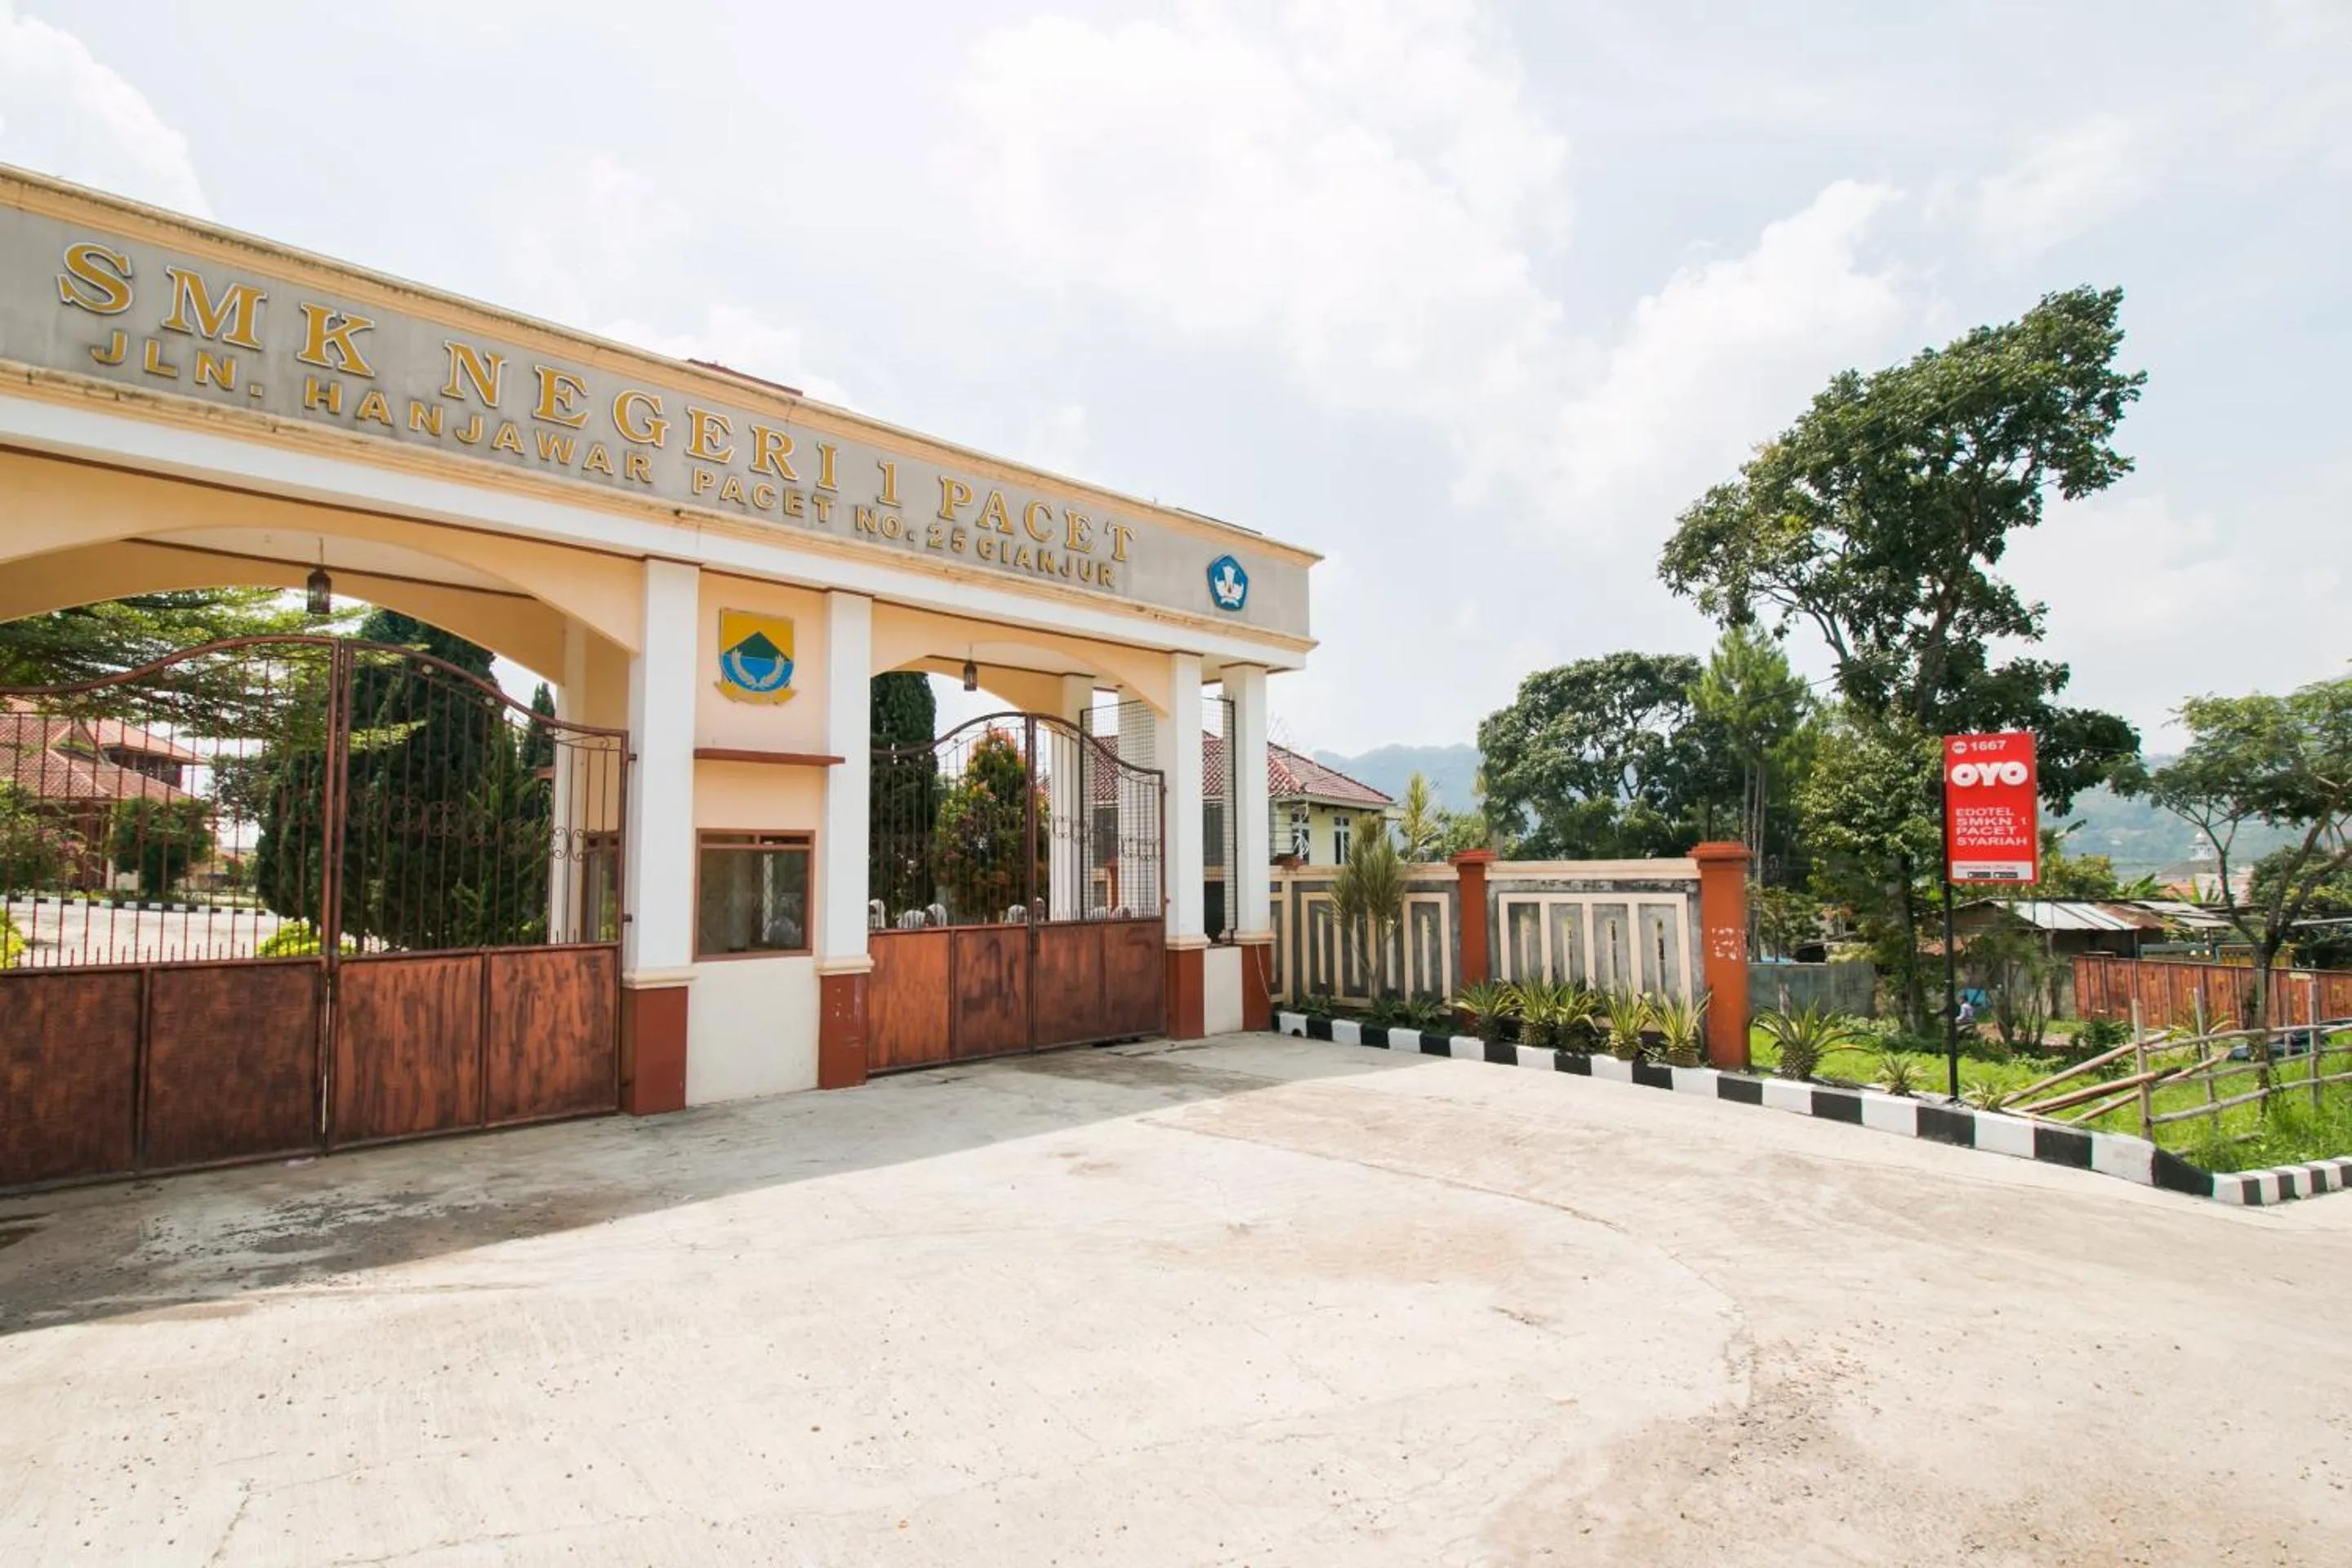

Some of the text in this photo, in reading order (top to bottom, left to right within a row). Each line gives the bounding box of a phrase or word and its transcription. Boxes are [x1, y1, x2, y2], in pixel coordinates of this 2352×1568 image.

[57, 242, 1136, 562] SMK NEGERI 1 PACET
[90, 331, 264, 398] JLN.
[303, 376, 653, 483] HANJAWAR
[693, 466, 835, 522] PACET
[856, 506, 915, 542] NO.
[927, 523, 966, 553] 25
[1970, 740, 2007, 751] 1667
[1951, 761, 2029, 786] OYO
[1956, 807, 2015, 817] EDOTEL
[1956, 817, 2028, 826] SMKN 1
[1957, 826, 2017, 835] PACET
[1957, 836, 2027, 846] SYARIAH
